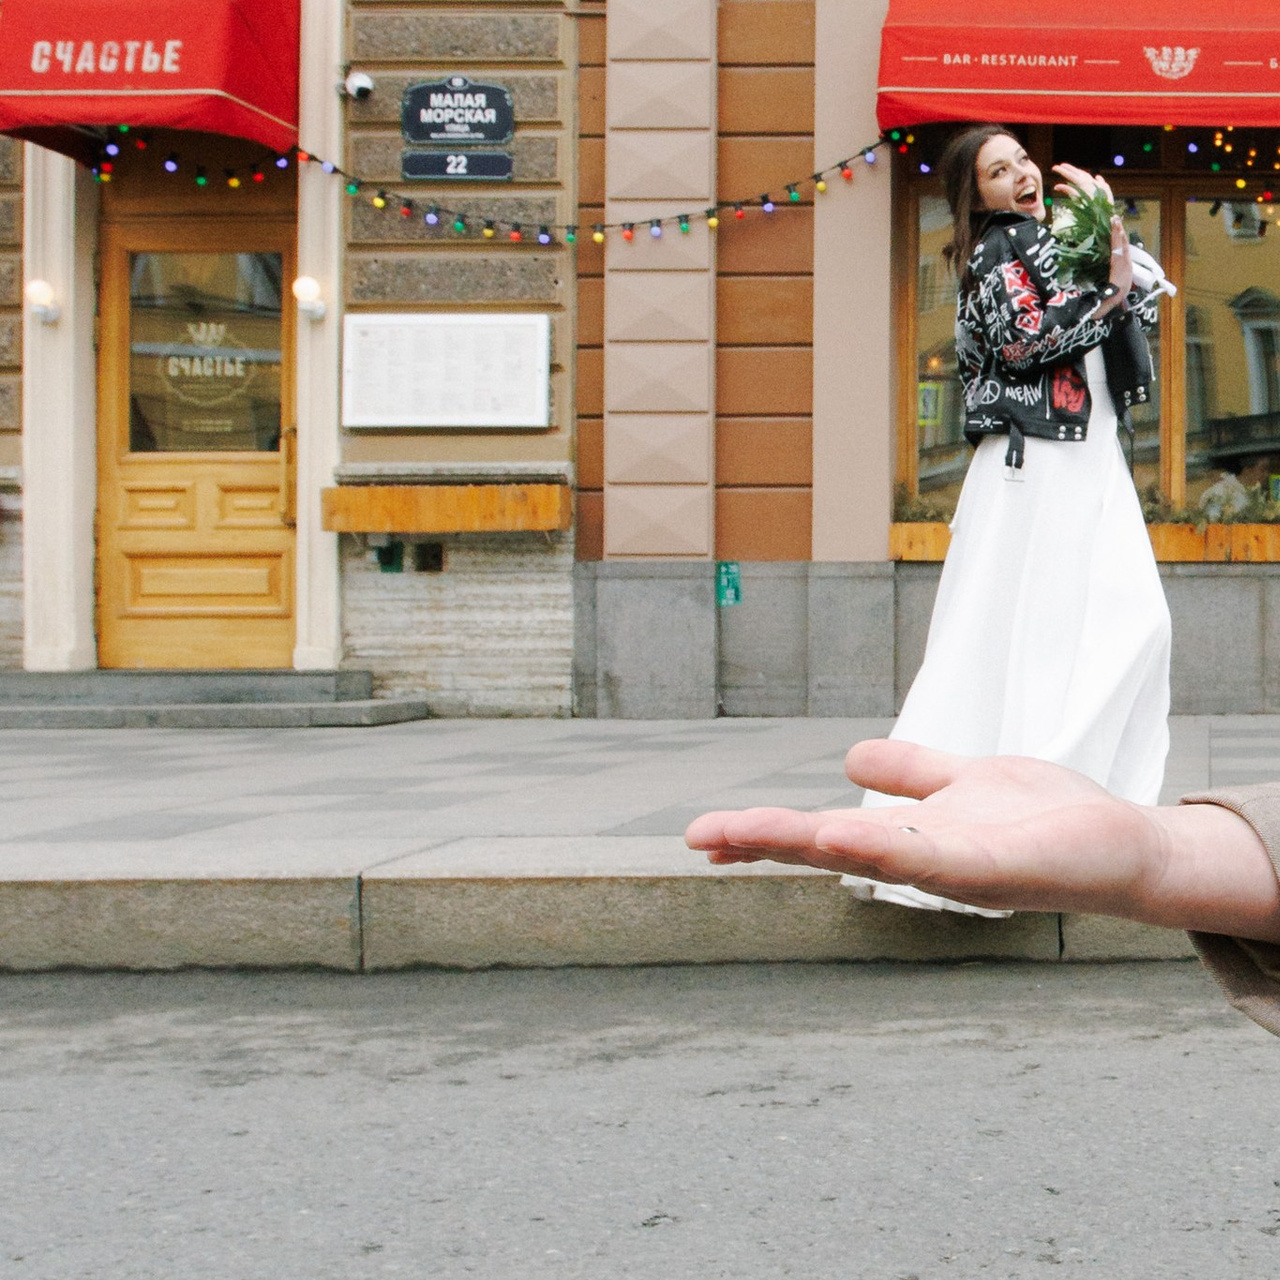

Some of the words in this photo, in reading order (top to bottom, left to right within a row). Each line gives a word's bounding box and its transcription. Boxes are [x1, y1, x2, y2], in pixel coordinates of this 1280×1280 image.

[31, 40, 183, 73] СЧАСТЬЕ
[943, 53, 971, 65] BAR
[981, 54, 1078, 66] RESTAURANT
[430, 93, 486, 108] МАЛАЯ
[420, 108, 496, 123] МОРСКАЯ
[446, 155, 468, 174] 22
[168, 356, 245, 377] СЧАСТЬЕ
